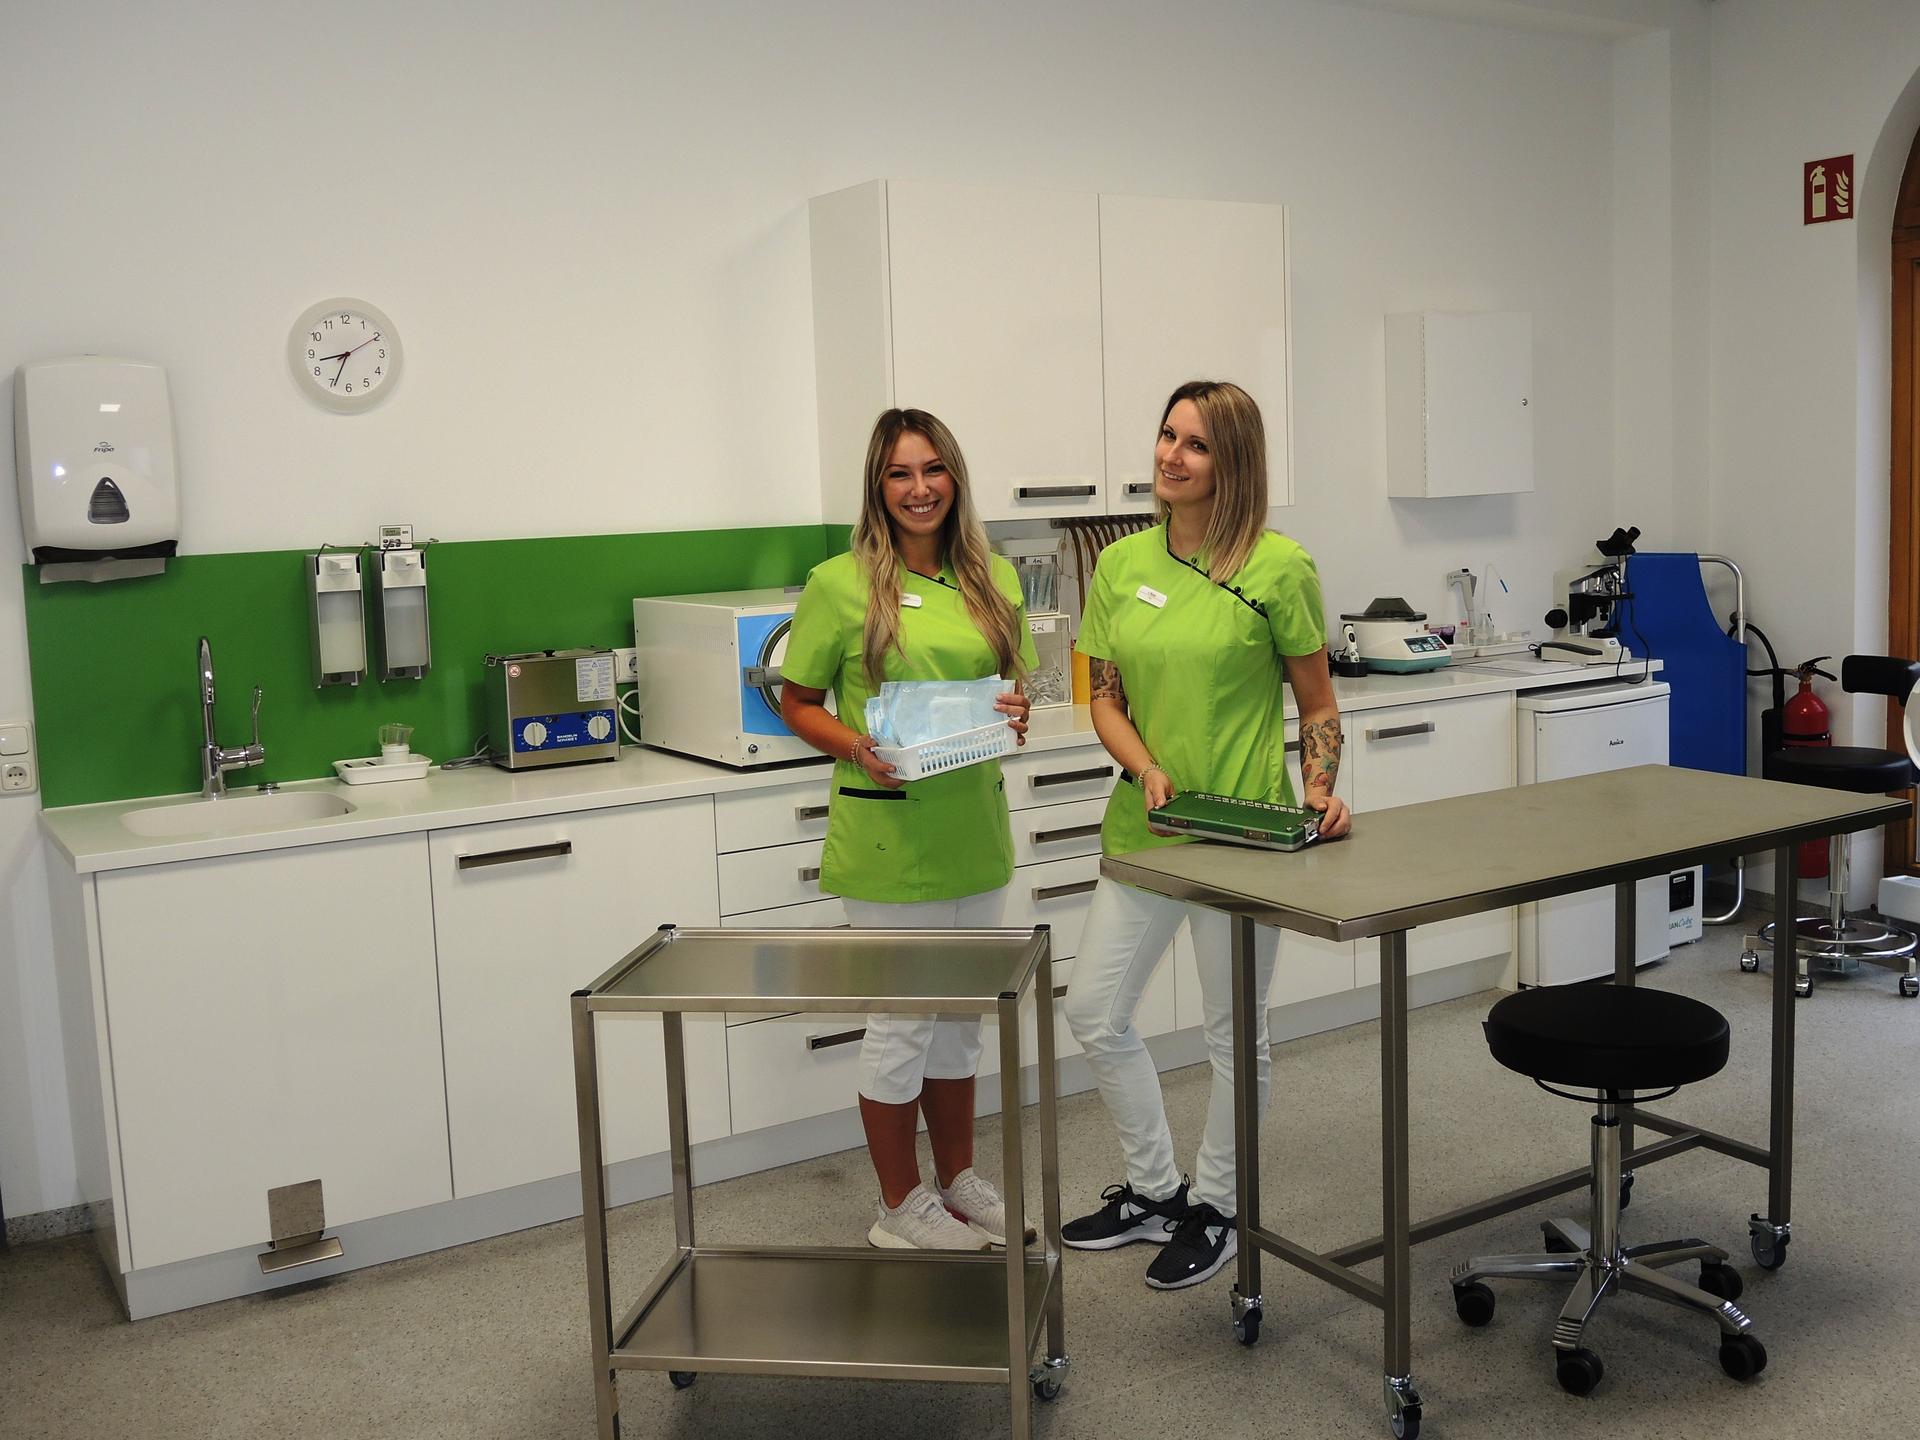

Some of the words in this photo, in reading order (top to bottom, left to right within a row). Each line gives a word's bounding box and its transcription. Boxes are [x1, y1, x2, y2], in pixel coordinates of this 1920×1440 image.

[340, 314, 351, 325] 12
[323, 320, 333, 330] 11
[361, 320, 366, 330] 1
[311, 332, 322, 342] 10
[373, 332, 381, 342] 2
[307, 349, 315, 359] 9
[378, 349, 385, 359] 3
[314, 366, 321, 376] 8
[374, 366, 382, 376] 4
[328, 378, 335, 388] 7
[345, 383, 352, 393] 6
[363, 378, 370, 388] 5
